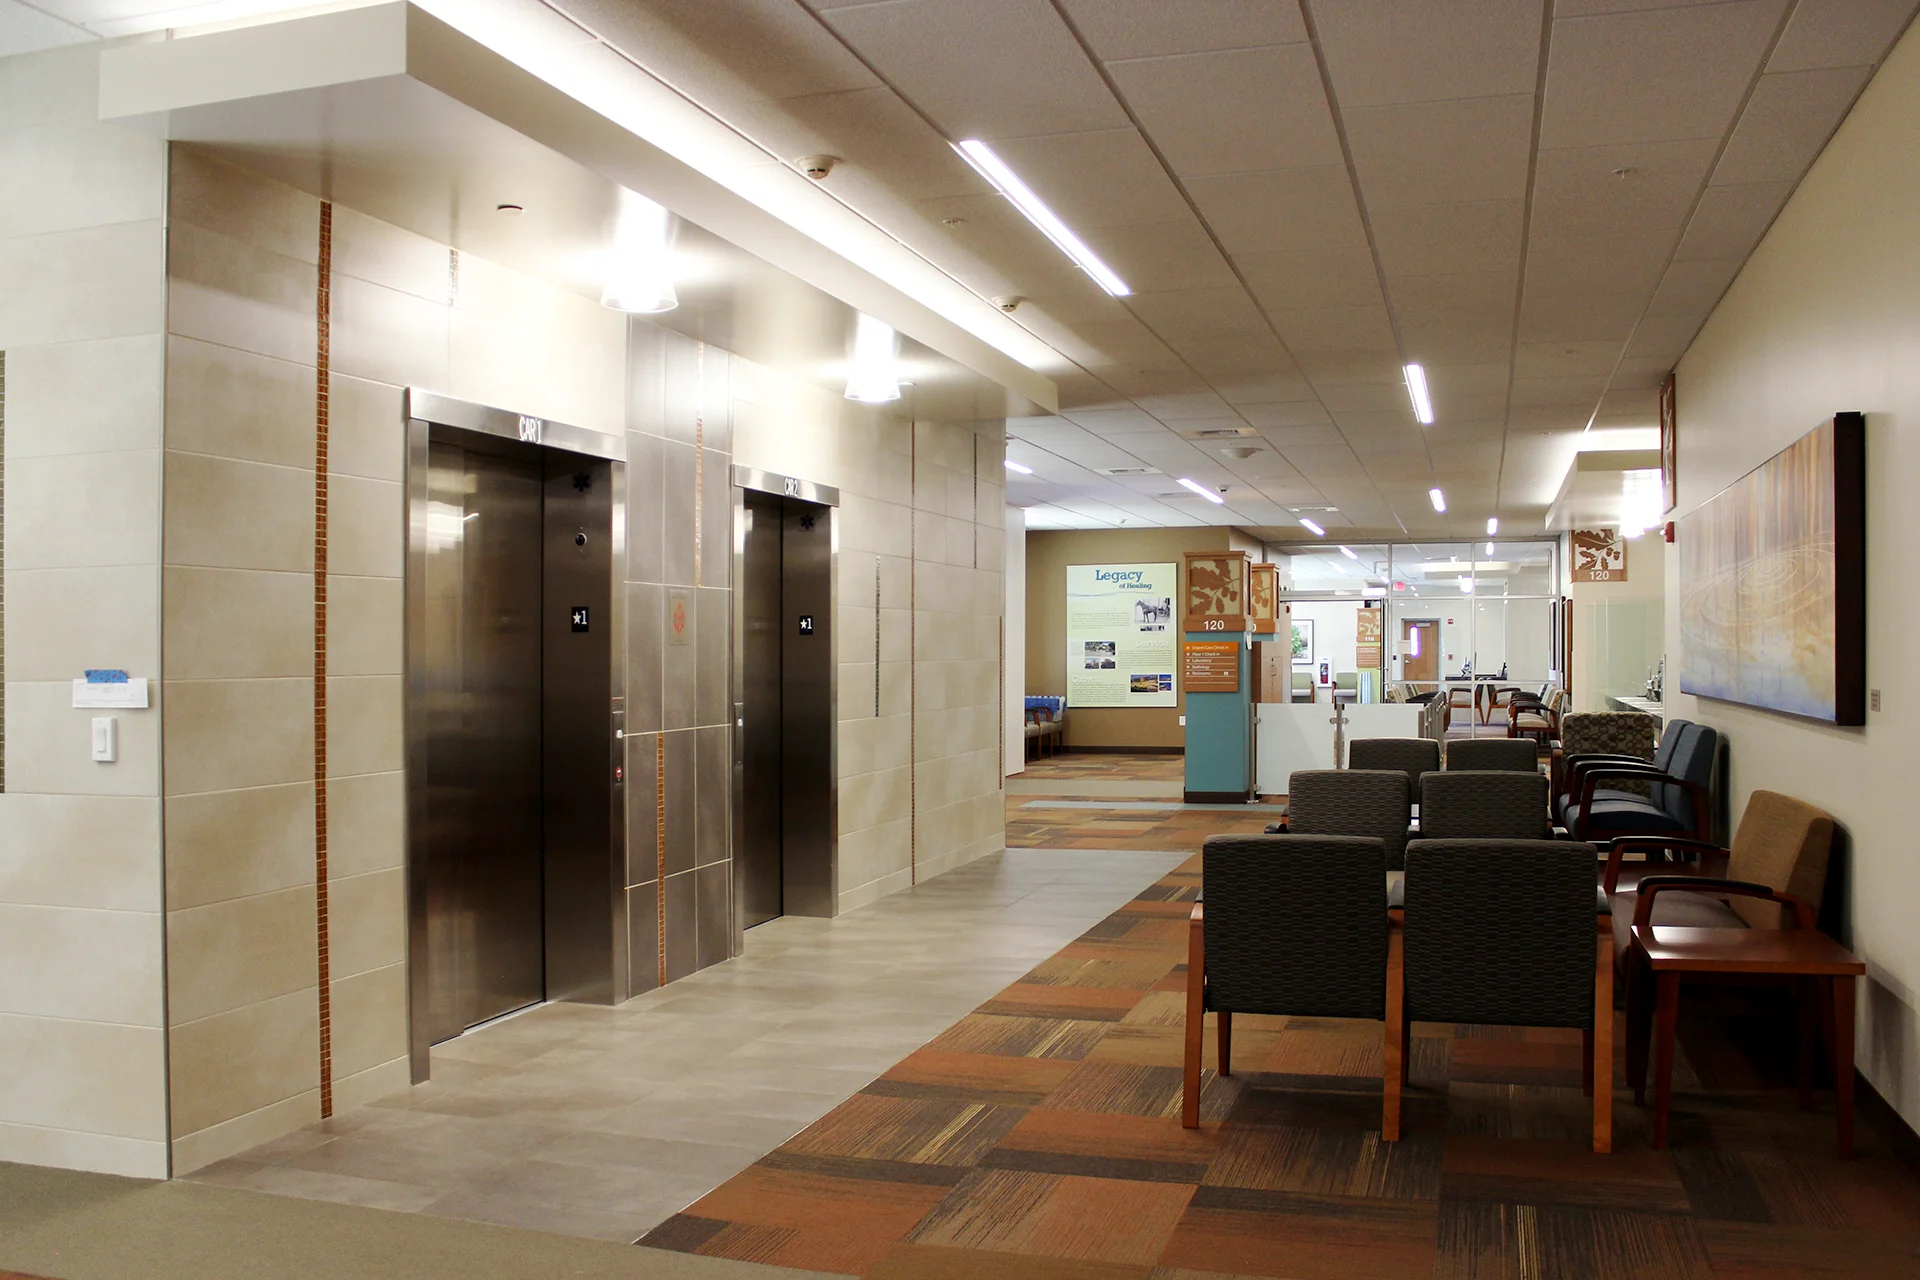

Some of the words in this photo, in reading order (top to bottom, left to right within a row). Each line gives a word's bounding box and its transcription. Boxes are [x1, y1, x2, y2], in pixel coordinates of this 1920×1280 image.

[519, 415, 536, 442] CAR
[536, 420, 542, 444] 1
[785, 477, 795, 496] CAR
[1095, 569, 1143, 583] Legacy
[1589, 570, 1609, 580] 120
[1204, 620, 1224, 630] 120
